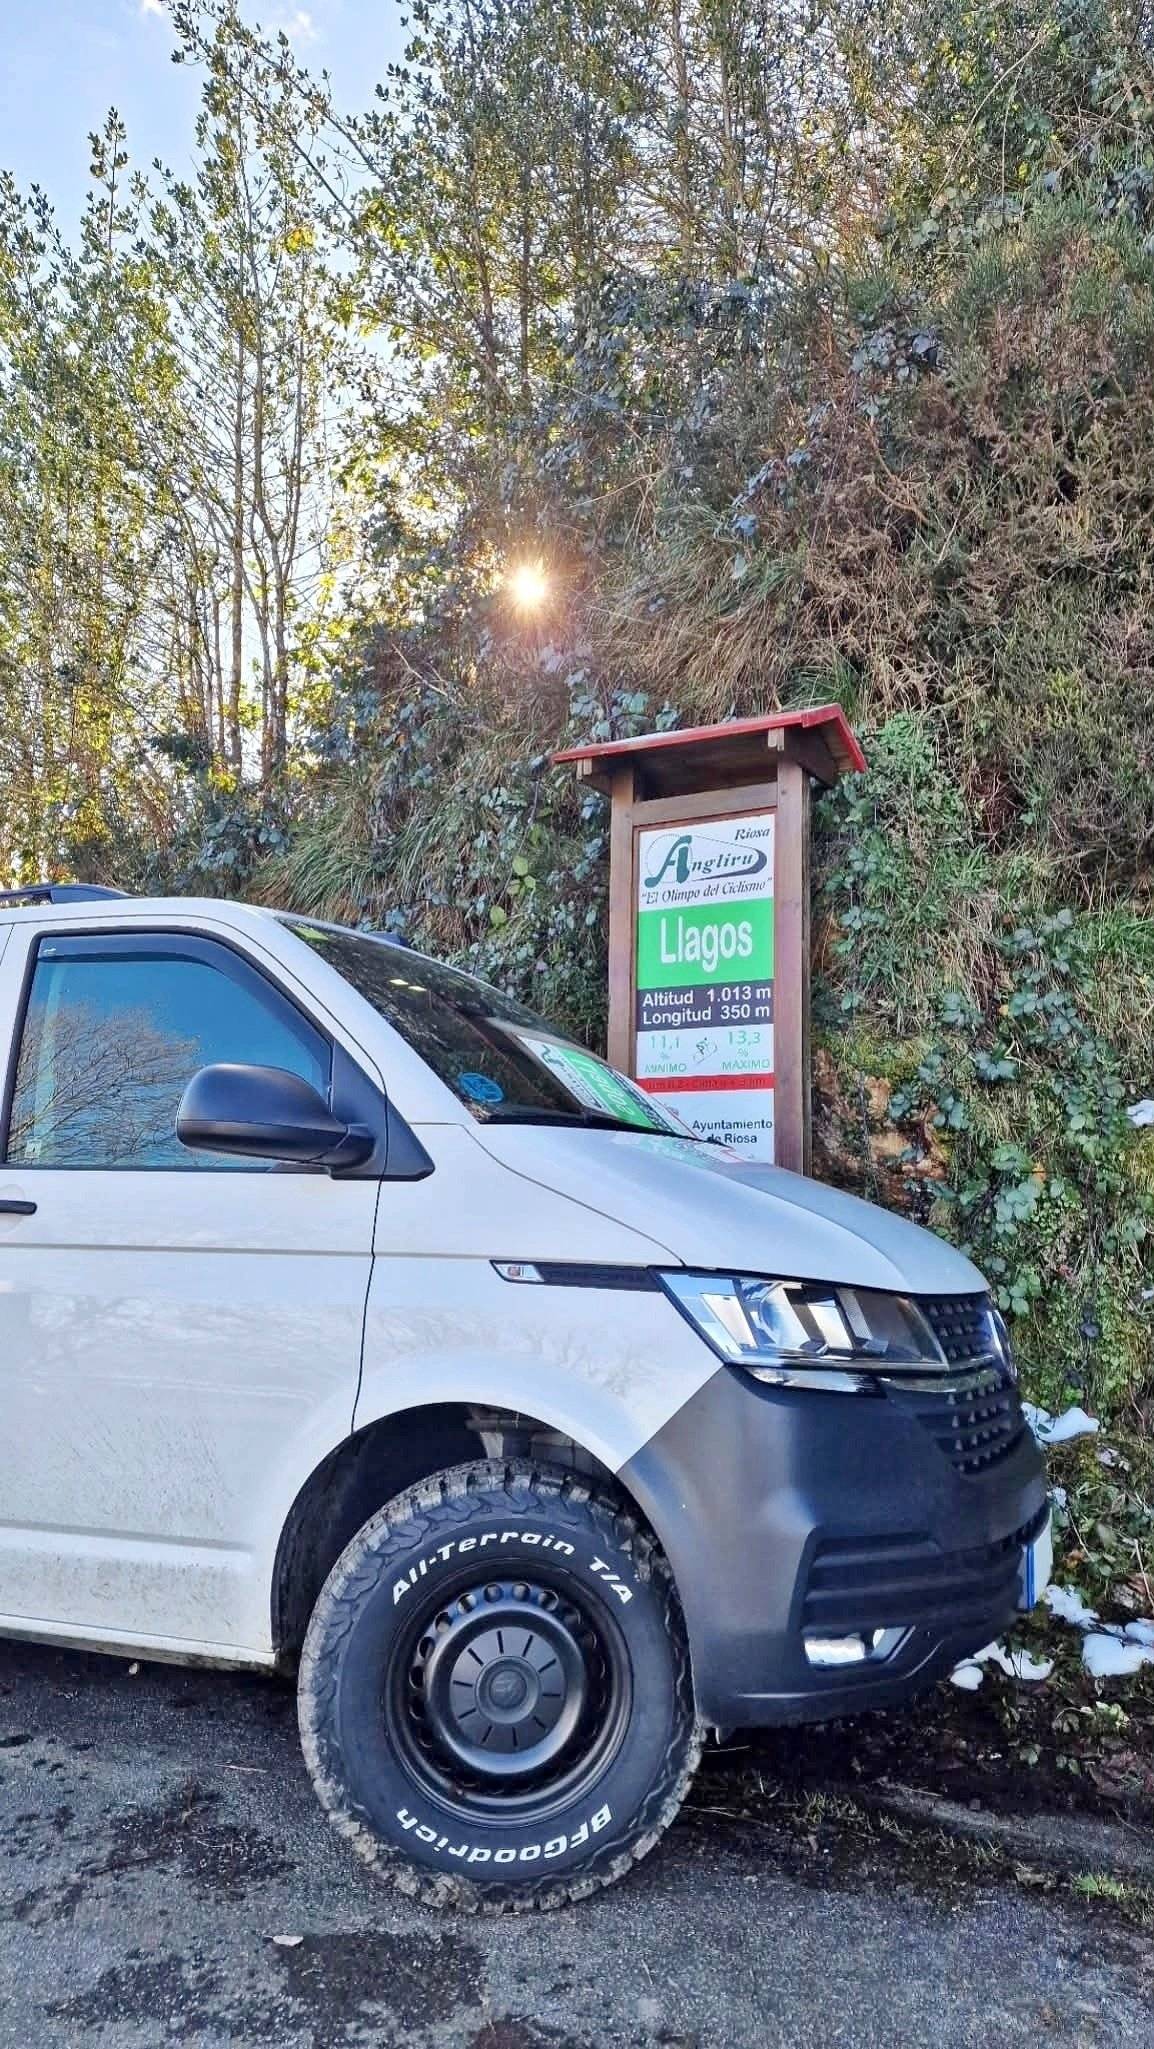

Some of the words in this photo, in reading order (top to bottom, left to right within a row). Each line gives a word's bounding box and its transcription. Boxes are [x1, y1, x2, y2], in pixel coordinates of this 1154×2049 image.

[735, 828, 770, 841] Riosa
[644, 834, 754, 889] Angliru
[662, 887, 701, 904] Olimpo
[703, 884, 719, 898] del
[660, 915, 753, 973] Llagos
[642, 989, 694, 1007] Altitud
[706, 985, 752, 1003] 1.013
[756, 986, 772, 1000] m
[643, 1006, 712, 1026] Longitud
[720, 1003, 751, 1020] 350
[755, 1005, 771, 1018] m
[651, 1034, 680, 1050] 11,1
[728, 1030, 761, 1046] 13,3
[692, 1119, 774, 1133] Ayuntamiento
[724, 1132, 758, 1144] Riosa
[392, 1530, 576, 1606] All-Terrain
[589, 1556, 634, 1604] T/A
[396, 1803, 613, 1864] BFGoodrich
